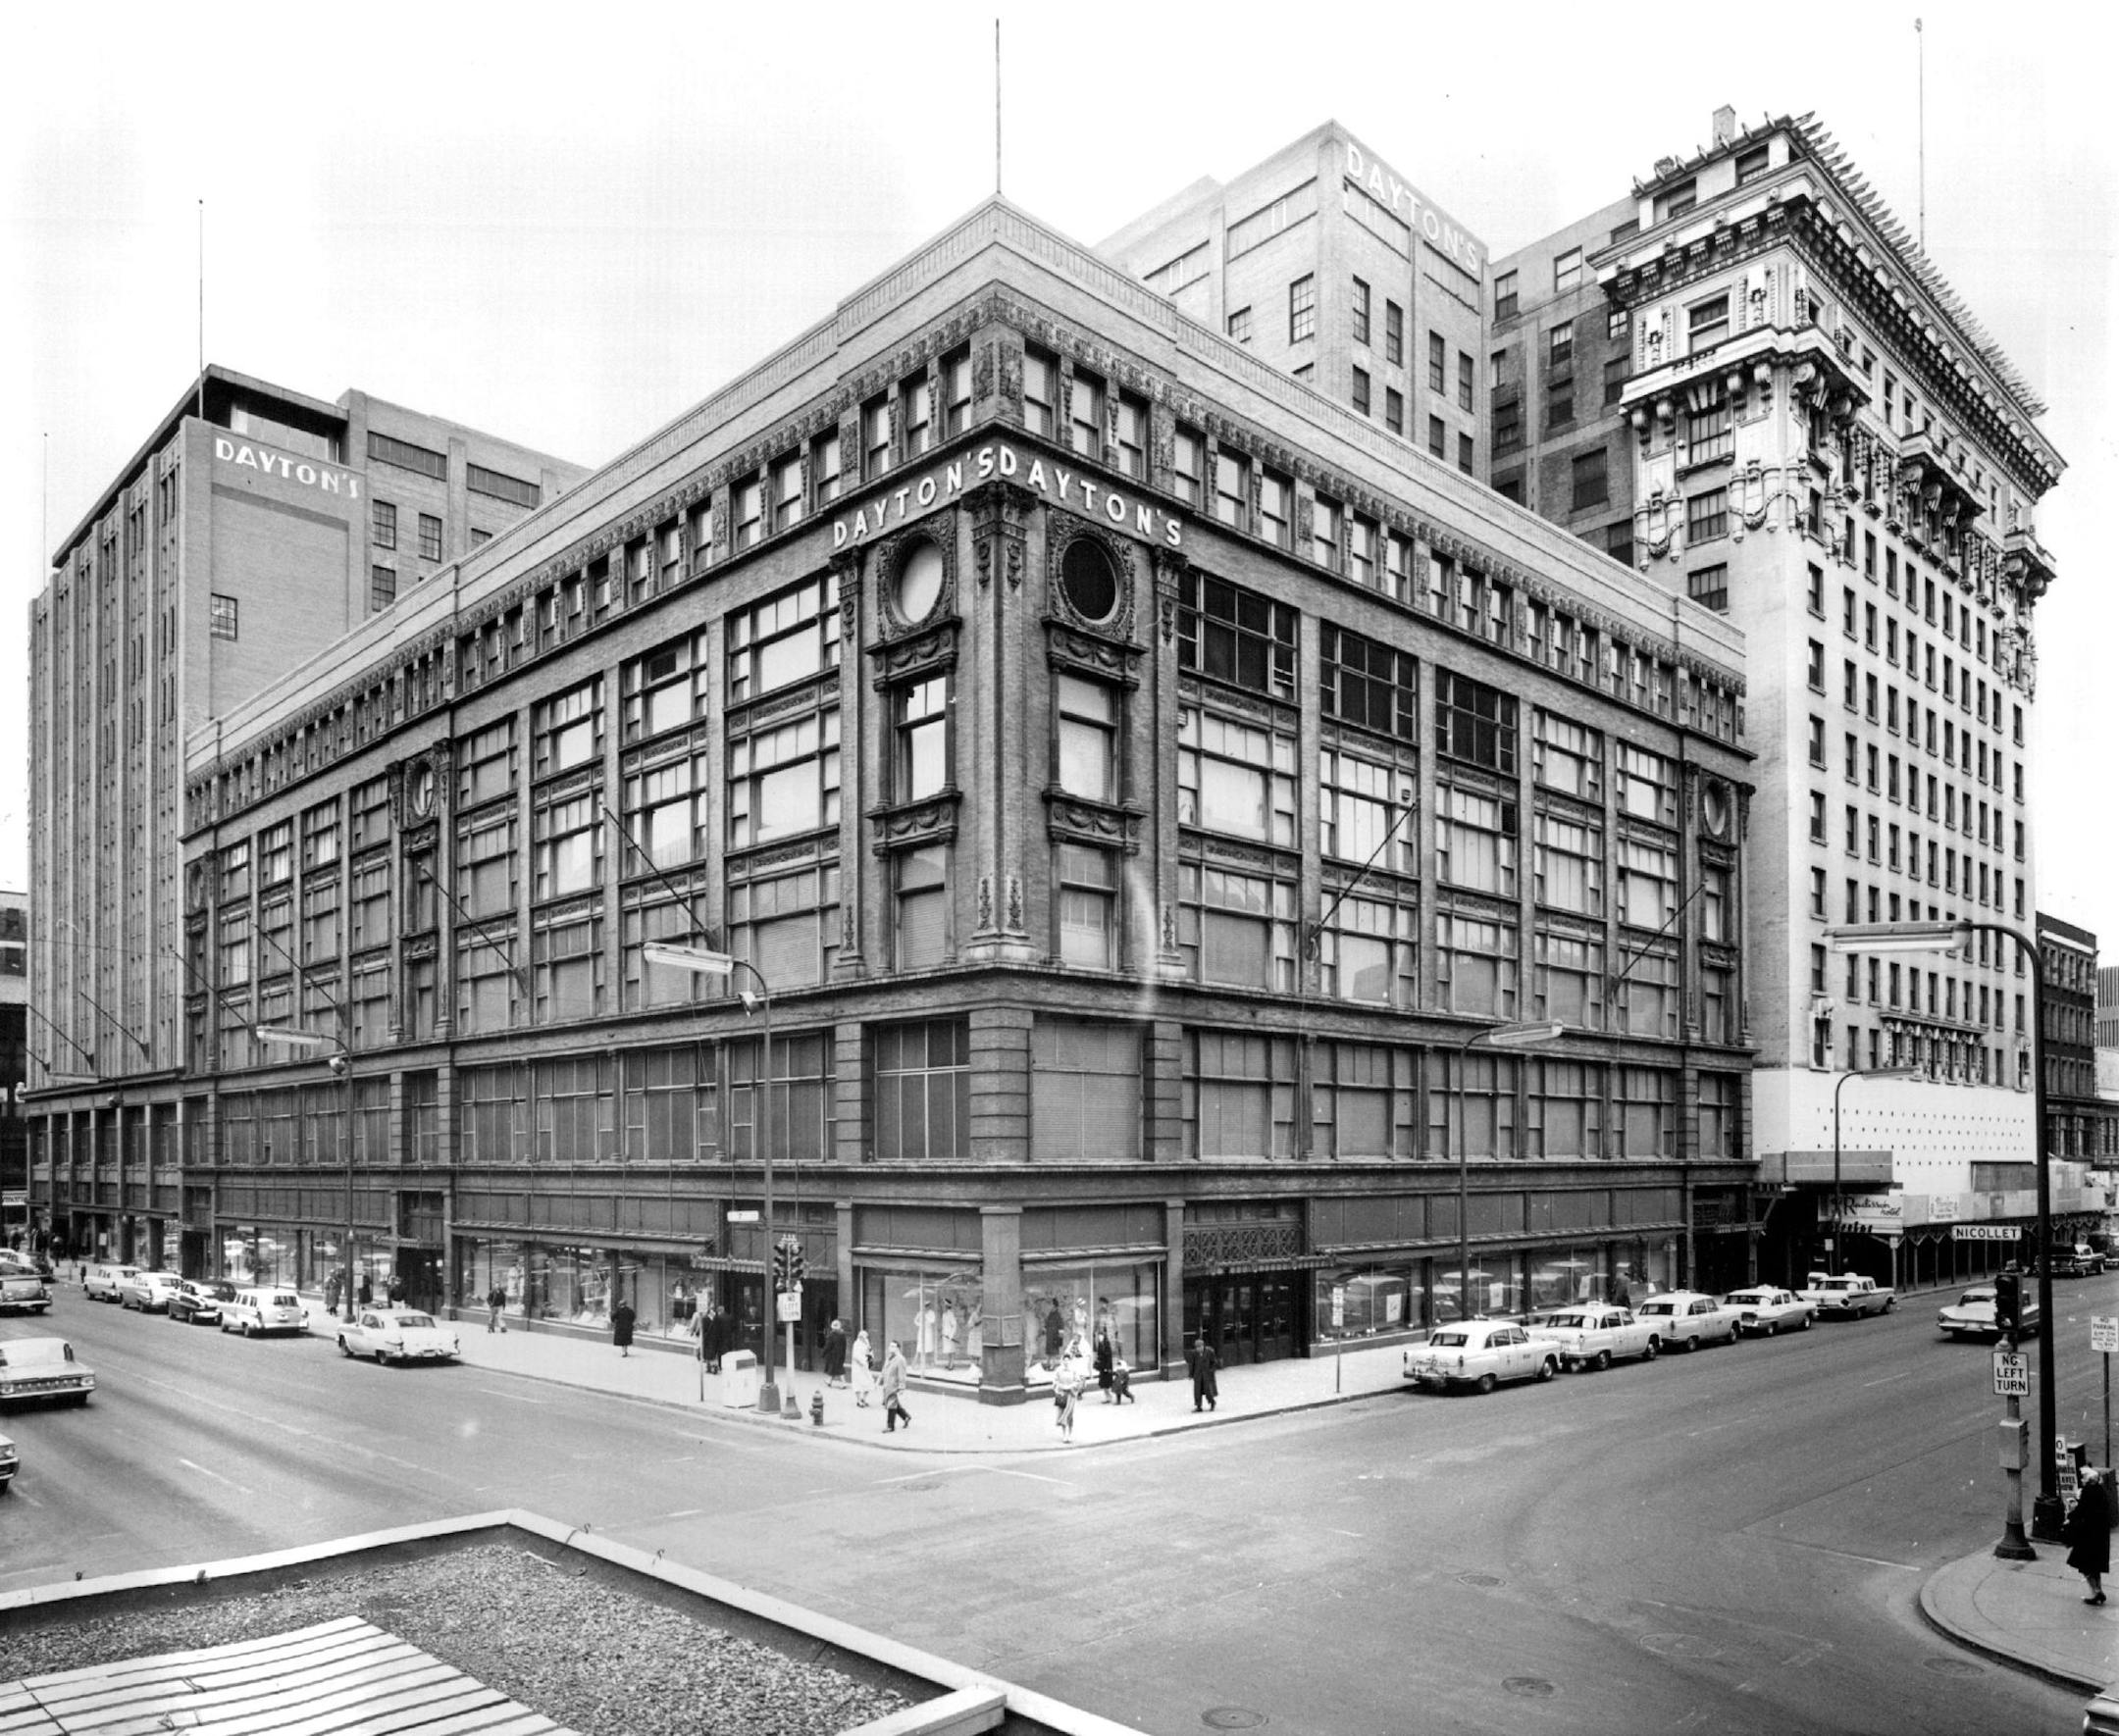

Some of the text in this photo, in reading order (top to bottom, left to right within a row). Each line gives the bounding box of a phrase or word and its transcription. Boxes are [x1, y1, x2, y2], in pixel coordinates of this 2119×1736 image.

[1348, 142, 1478, 274] DAYTON'S
[215, 437, 359, 498] DAYTON'S
[833, 446, 995, 548] DAYTON'S
[999, 444, 1182, 546] DAYTON'S
[1956, 1228, 2018, 1239] NICOLLET
[1996, 1367, 2024, 1379] LEFT
[2002, 1354, 2019, 1366] NO
[1996, 1379, 2026, 1392] TURN
